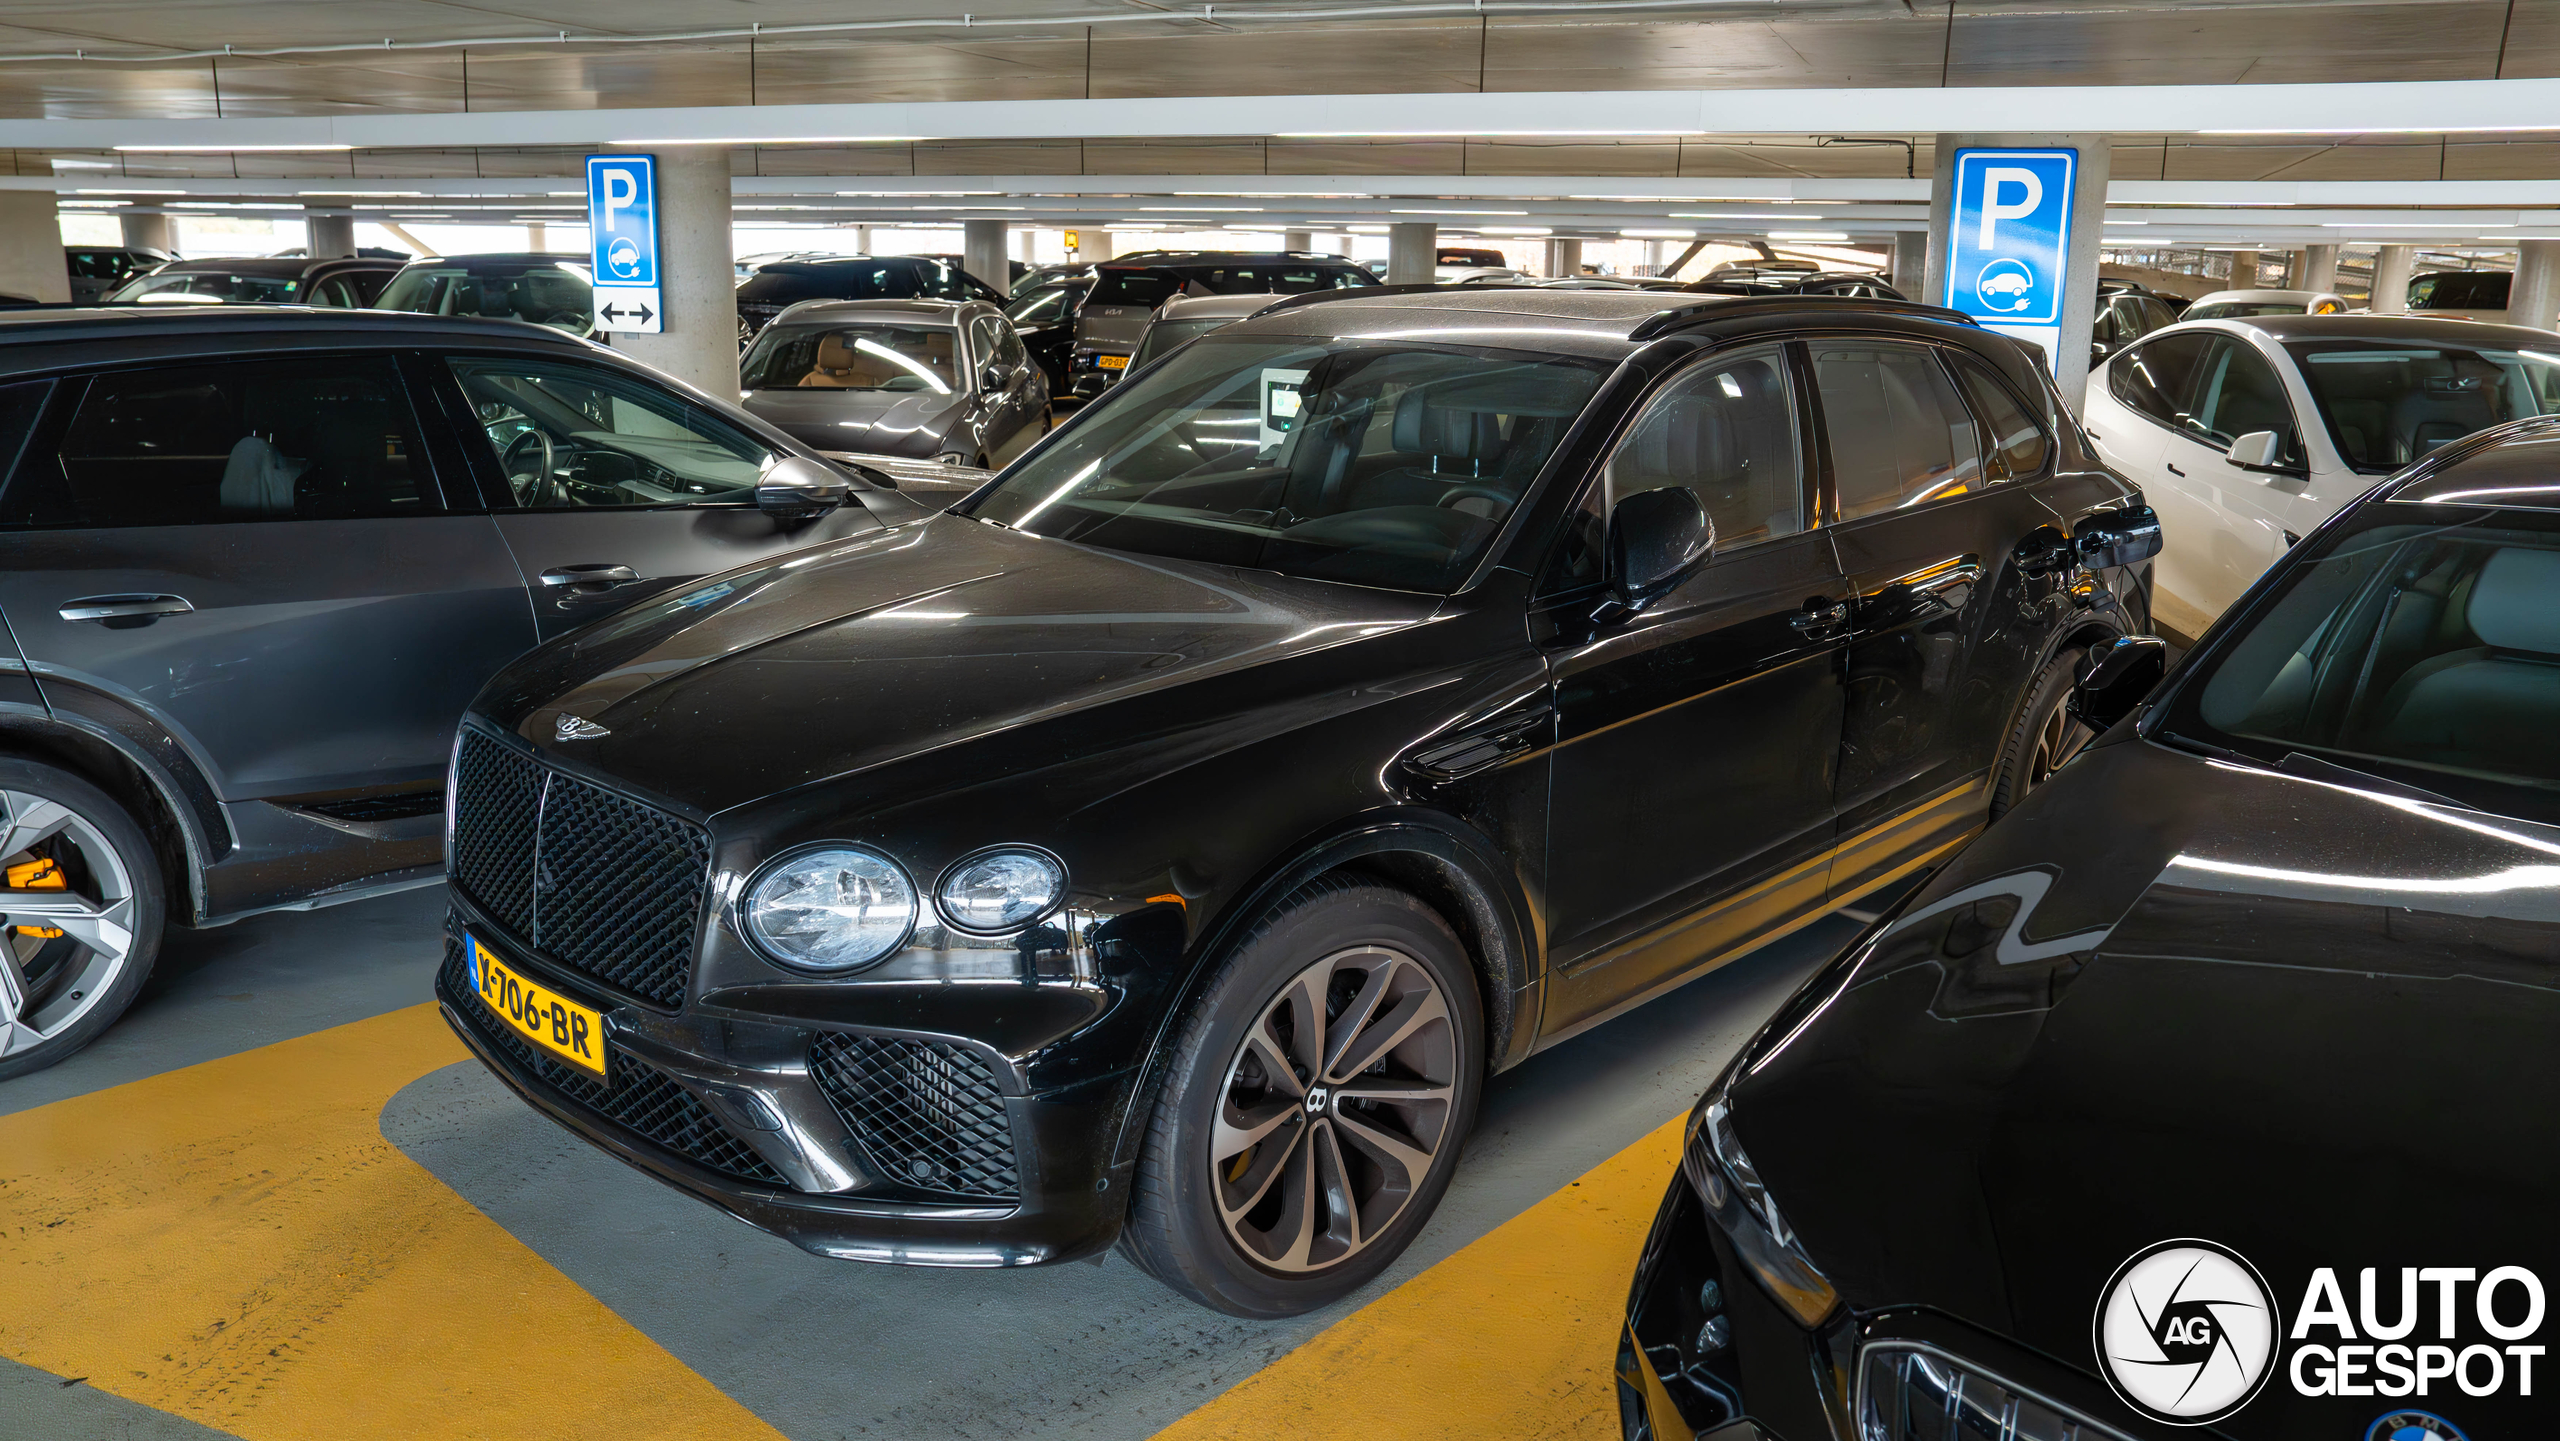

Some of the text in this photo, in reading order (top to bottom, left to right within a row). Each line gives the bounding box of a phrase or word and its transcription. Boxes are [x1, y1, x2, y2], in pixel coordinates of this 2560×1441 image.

[603, 169, 637, 232] P
[1979, 168, 2043, 250] P
[479, 953, 592, 1059] X-706-BR
